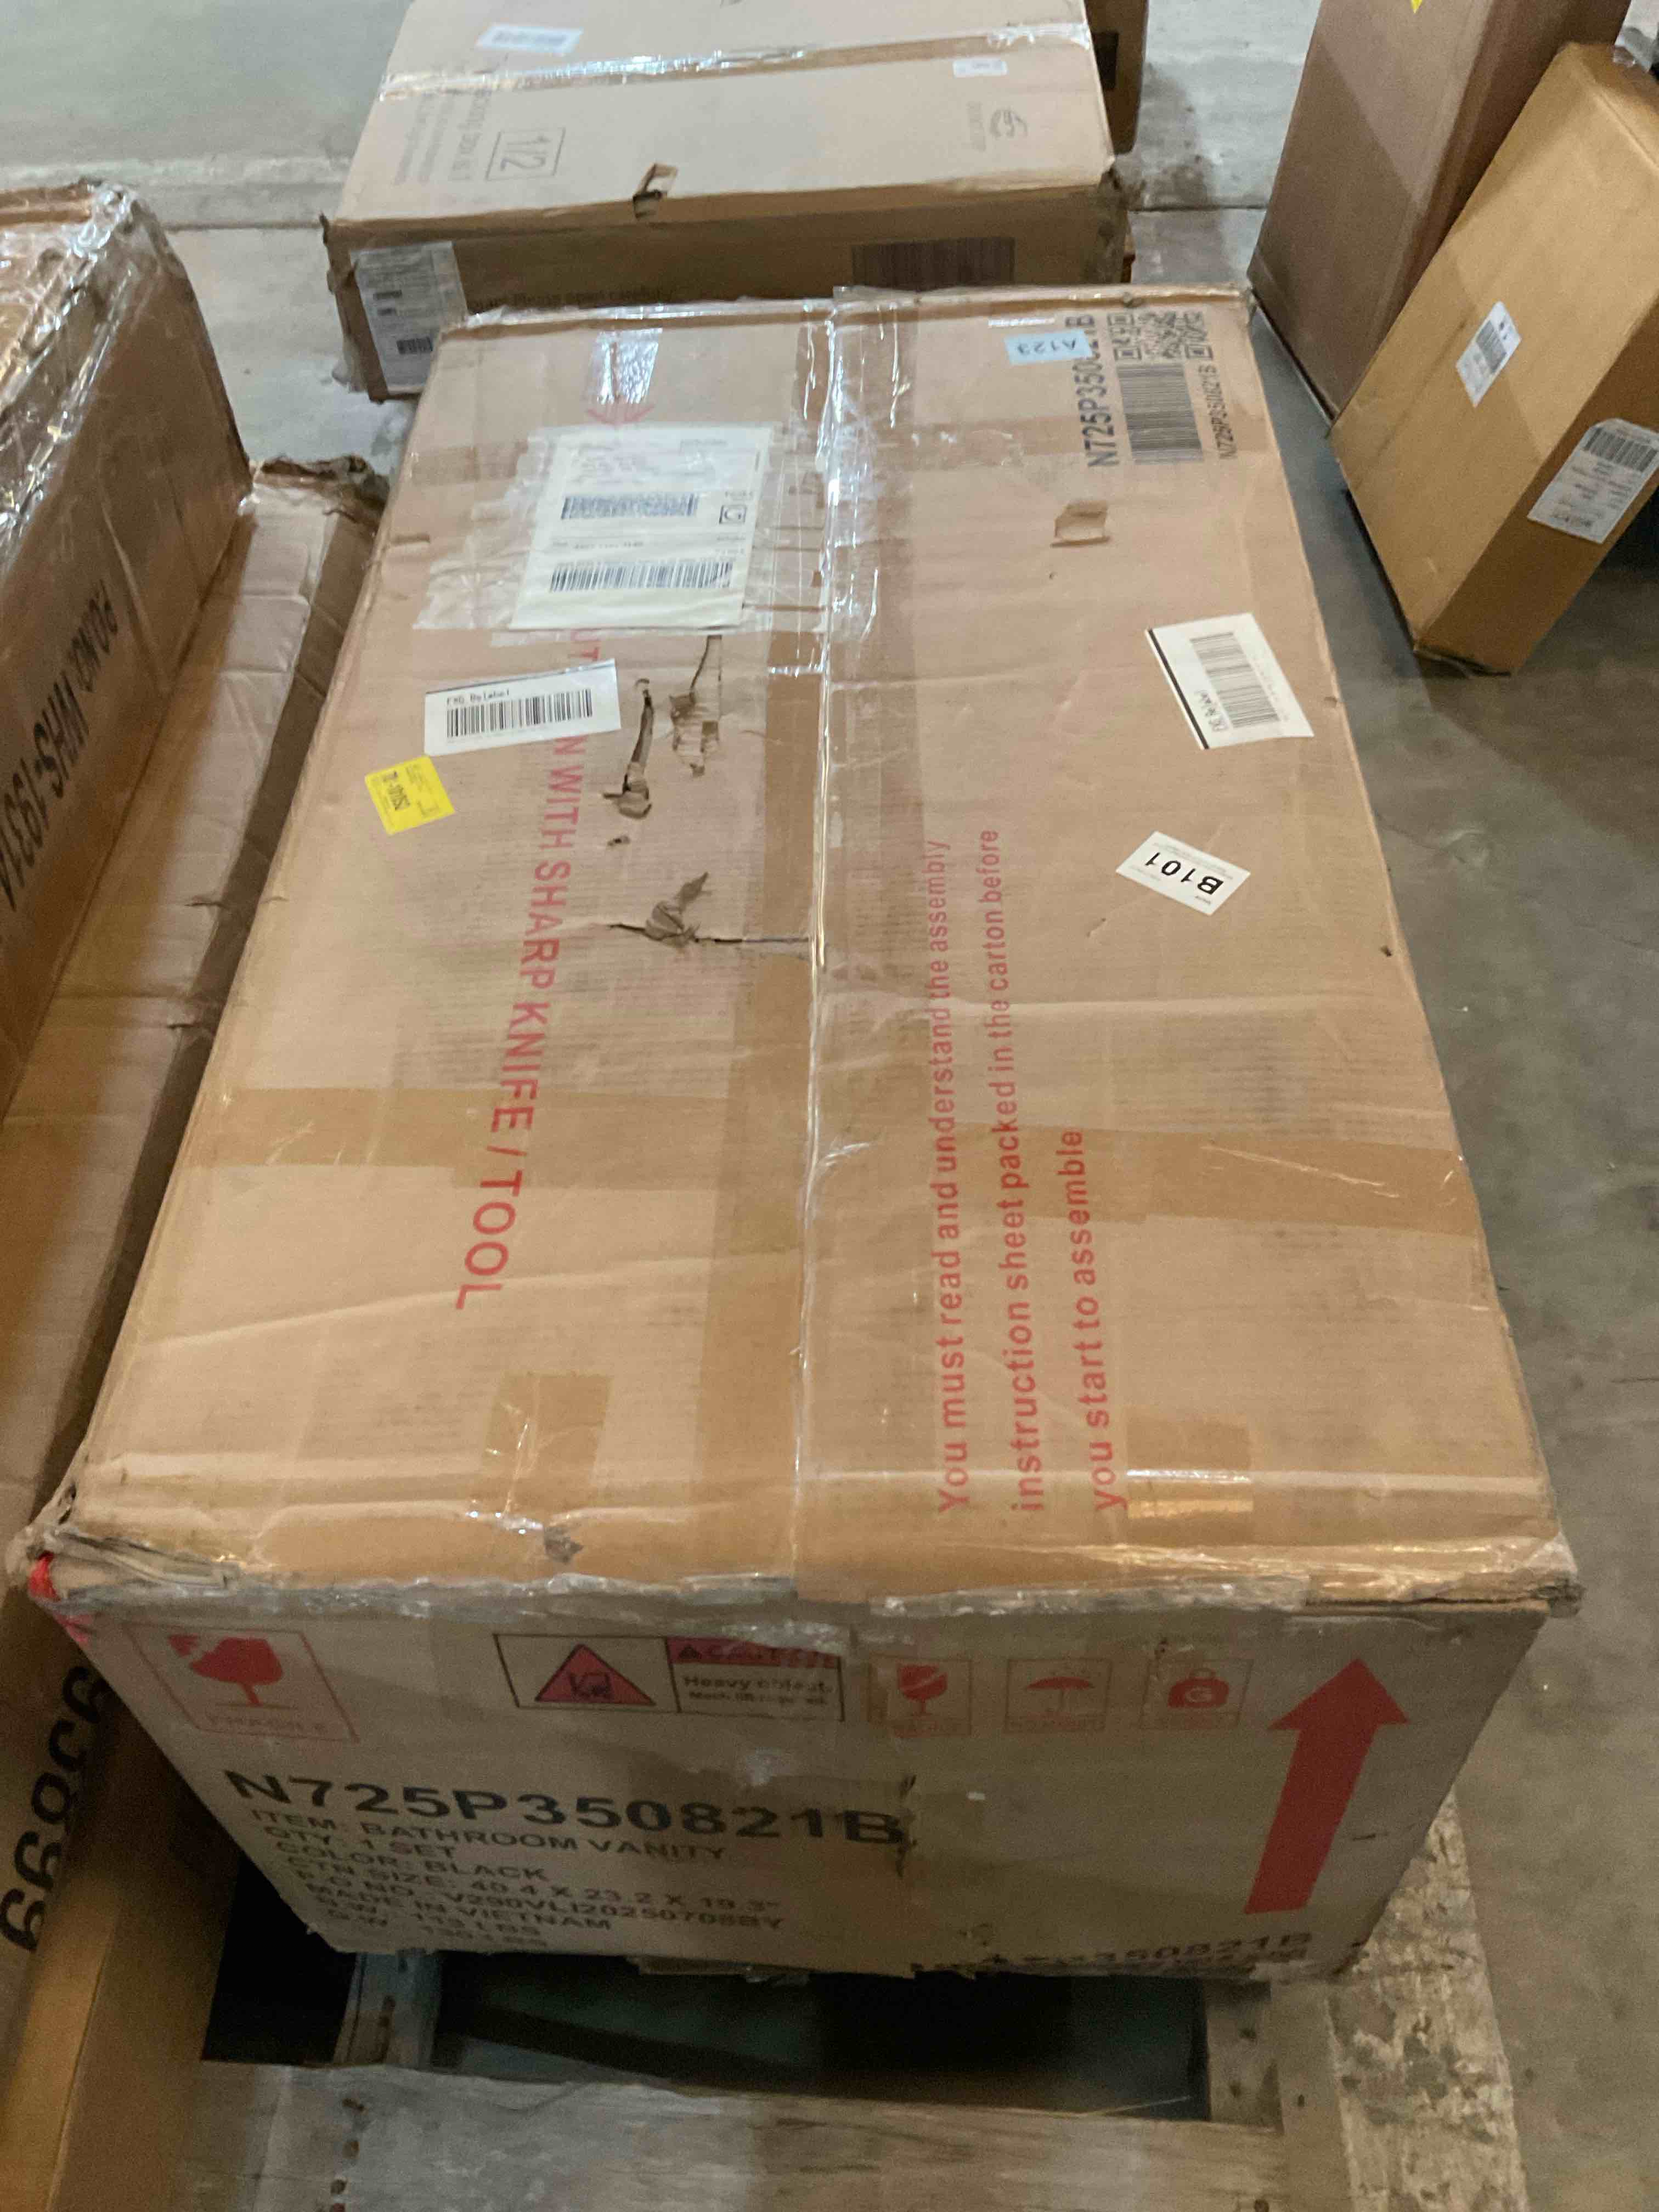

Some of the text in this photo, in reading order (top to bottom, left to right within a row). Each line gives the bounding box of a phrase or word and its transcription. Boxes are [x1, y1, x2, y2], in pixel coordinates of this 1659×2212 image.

[539, 765, 584, 850] WITH
[922, 840, 950, 952] assembly
[1144, 851, 1223, 895] B101
[519, 860, 572, 990] SHARP
[926, 960, 951, 999] the
[491, 1001, 551, 1133] KNIFE
[927, 1008, 958, 1172] understand
[930, 1181, 960, 1239] and
[977, 830, 1044, 1511] instruction sheet packed in the carton before
[455, 1169, 524, 1310] TOOL
[931, 1250, 963, 1326] read
[1057, 1130, 1130, 1511] you start to assemble
[935, 1334, 966, 1427] must
[223, 1768, 905, 1846] N725P350821B
[360, 1820, 578, 1850] BATHROOM
[588, 1838, 727, 1860] VANITY
[388, 1841, 454, 1858] SET
[424, 1860, 549, 1881] BLACK
[454, 1906, 611, 1930] VIETNAM
